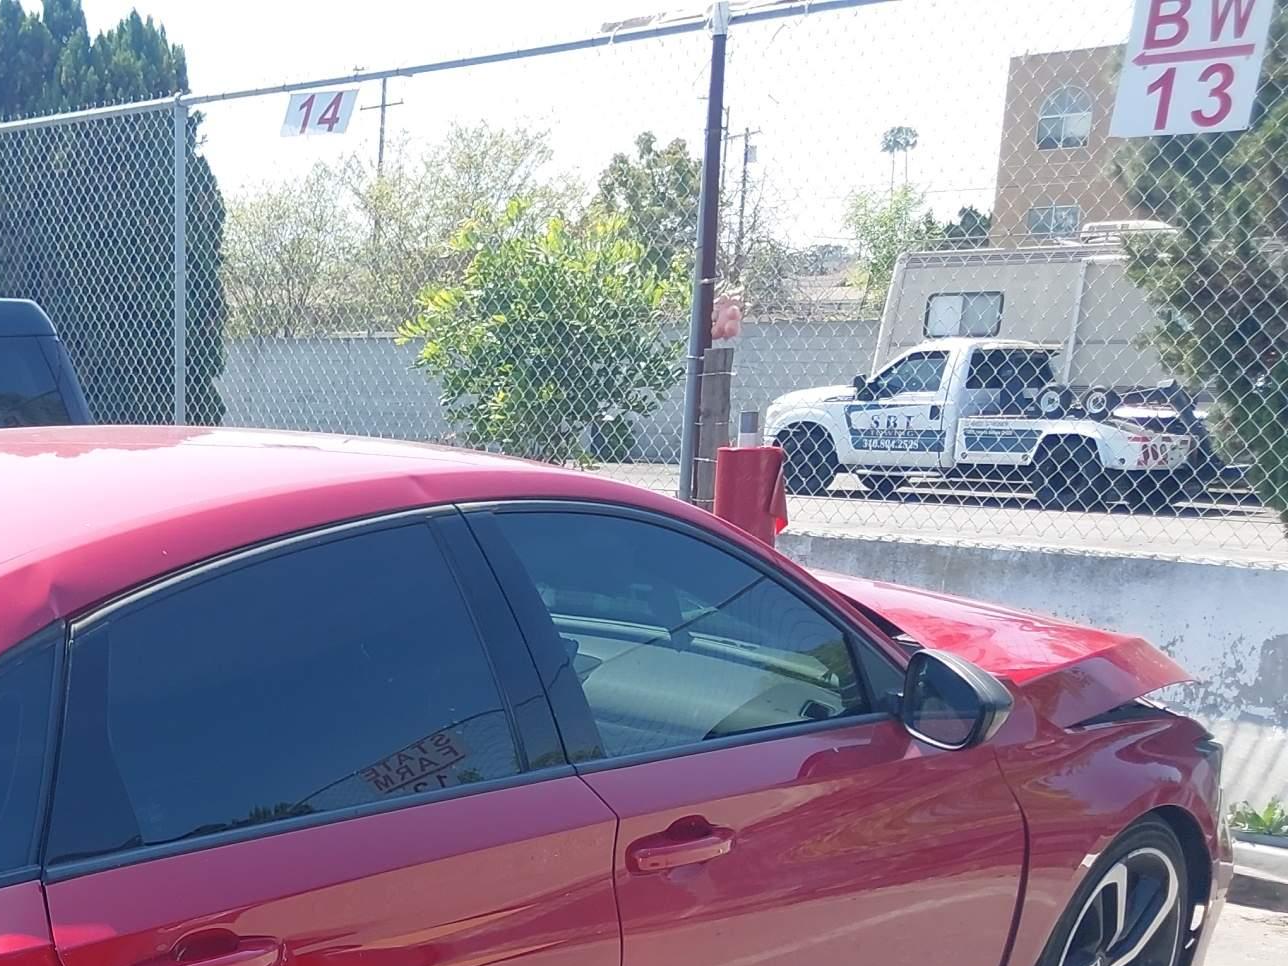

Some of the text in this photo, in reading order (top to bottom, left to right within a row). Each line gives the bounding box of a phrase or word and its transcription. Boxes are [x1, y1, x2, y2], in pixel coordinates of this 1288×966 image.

[1142, 0, 1255, 50] BW
[298, 91, 344, 135] 14
[1146, 62, 1235, 131] 13
